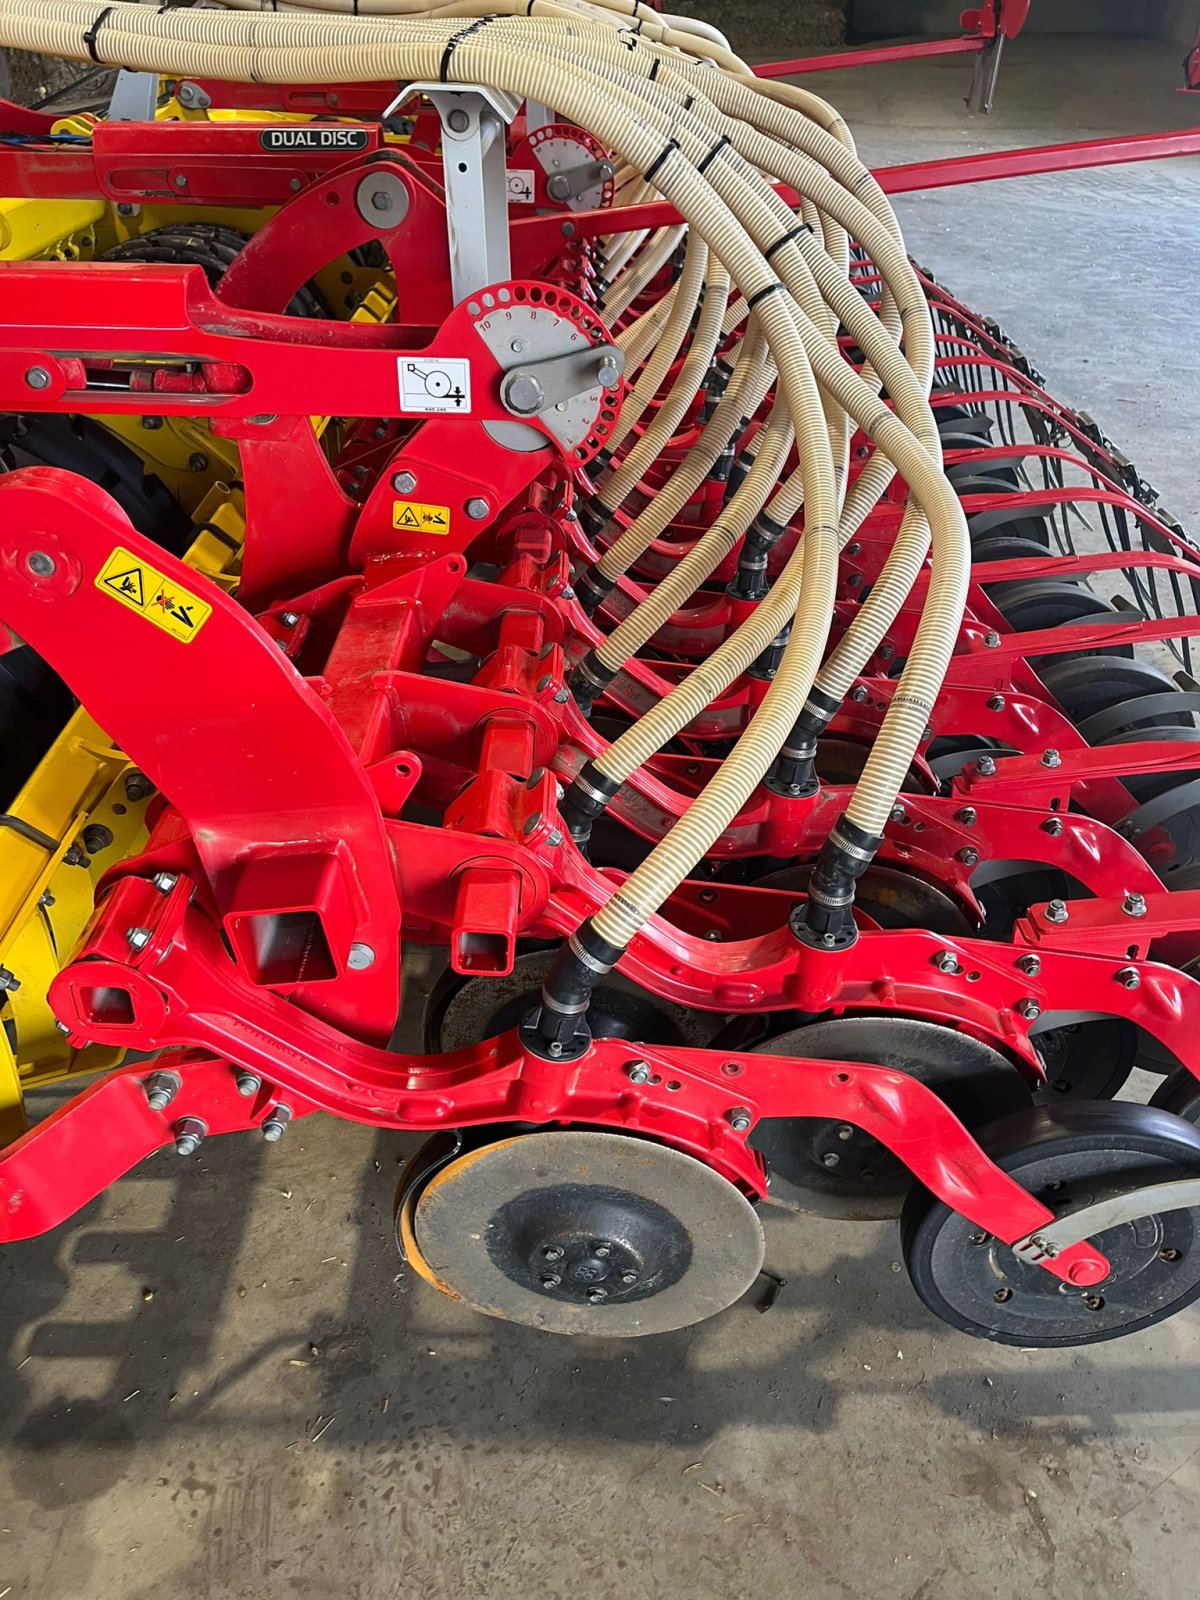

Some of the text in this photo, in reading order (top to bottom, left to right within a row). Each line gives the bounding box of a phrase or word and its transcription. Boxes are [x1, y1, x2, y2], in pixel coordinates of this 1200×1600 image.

[271, 132, 357, 146] DUAL DISC
[480, 320, 491, 332] 10
[505, 311, 512, 321] 9
[530, 311, 537, 320] 8
[552, 318, 561, 327] 7
